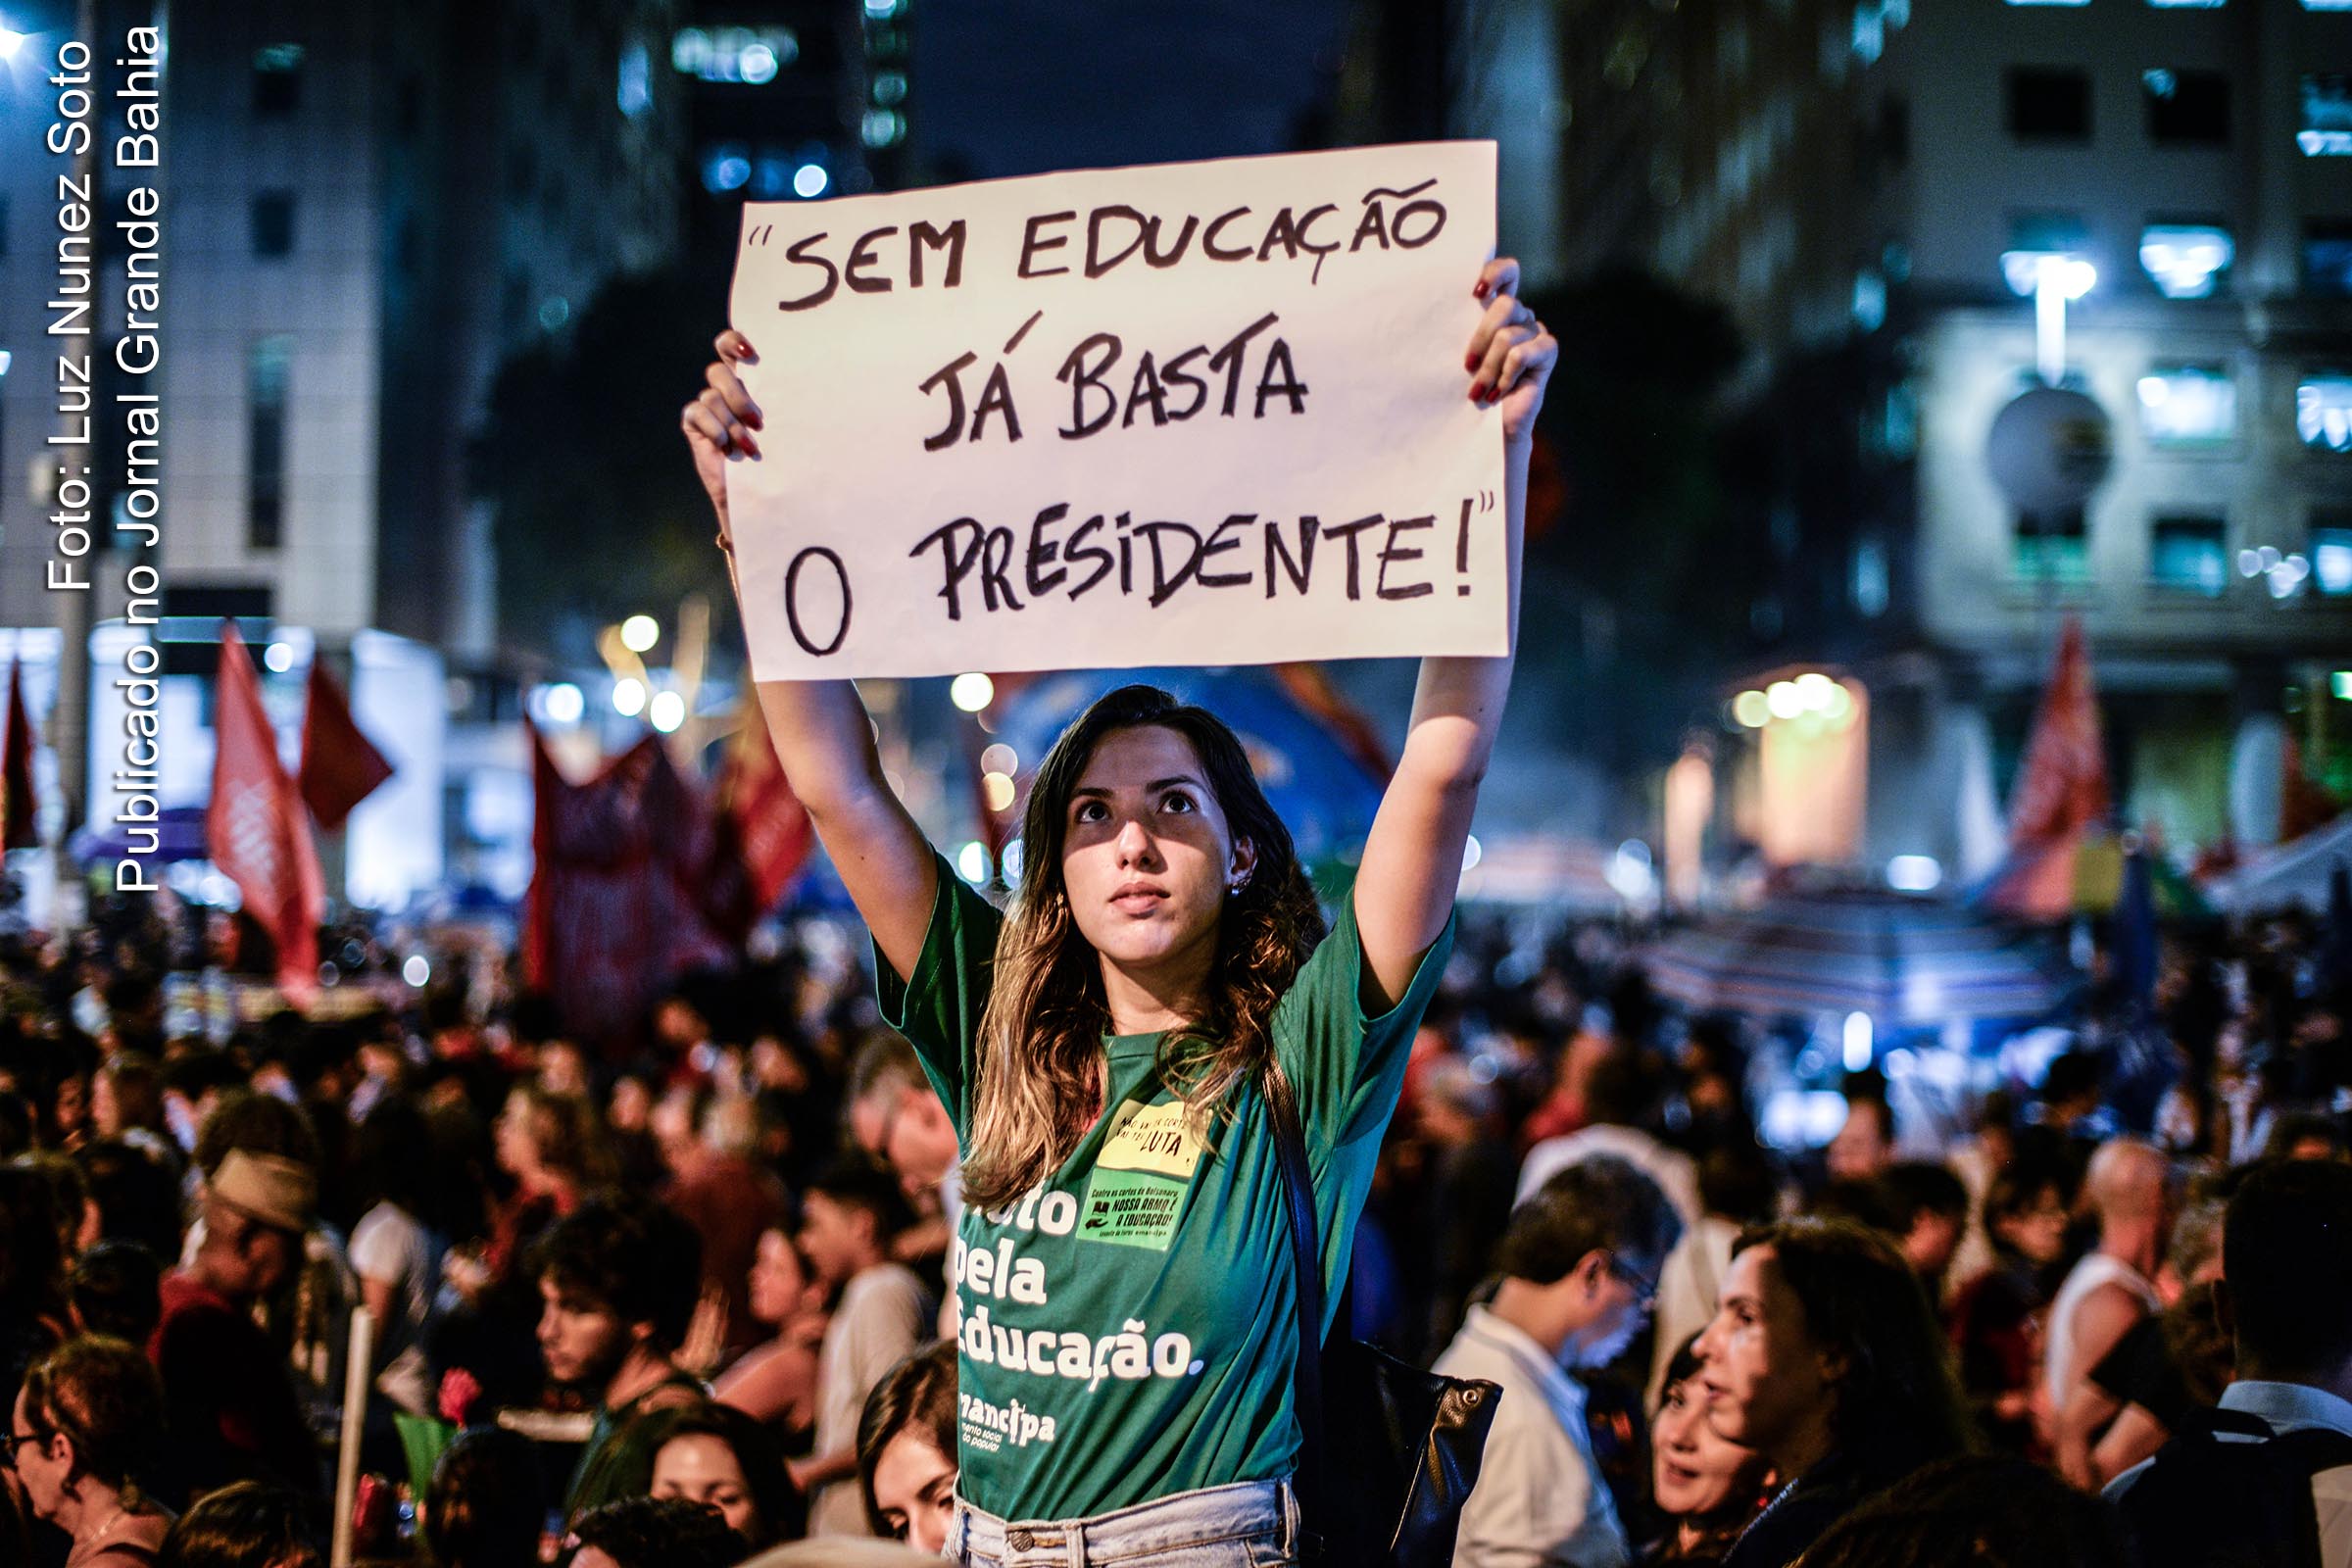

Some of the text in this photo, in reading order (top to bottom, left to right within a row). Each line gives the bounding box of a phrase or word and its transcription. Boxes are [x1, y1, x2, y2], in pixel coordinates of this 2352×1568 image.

[1017, 178, 1446, 284] EDUCAÇÃO
[918, 311, 1309, 452] JÁ BASTA
[784, 546, 853, 658] O
[1139, 1130, 1182, 1156] LUTA
[1111, 1198, 1141, 1212] NOSSA
[1170, 1197, 1178, 1211] É
[1116, 1214, 1124, 1227] A
[970, 1436, 1001, 1453] popular
